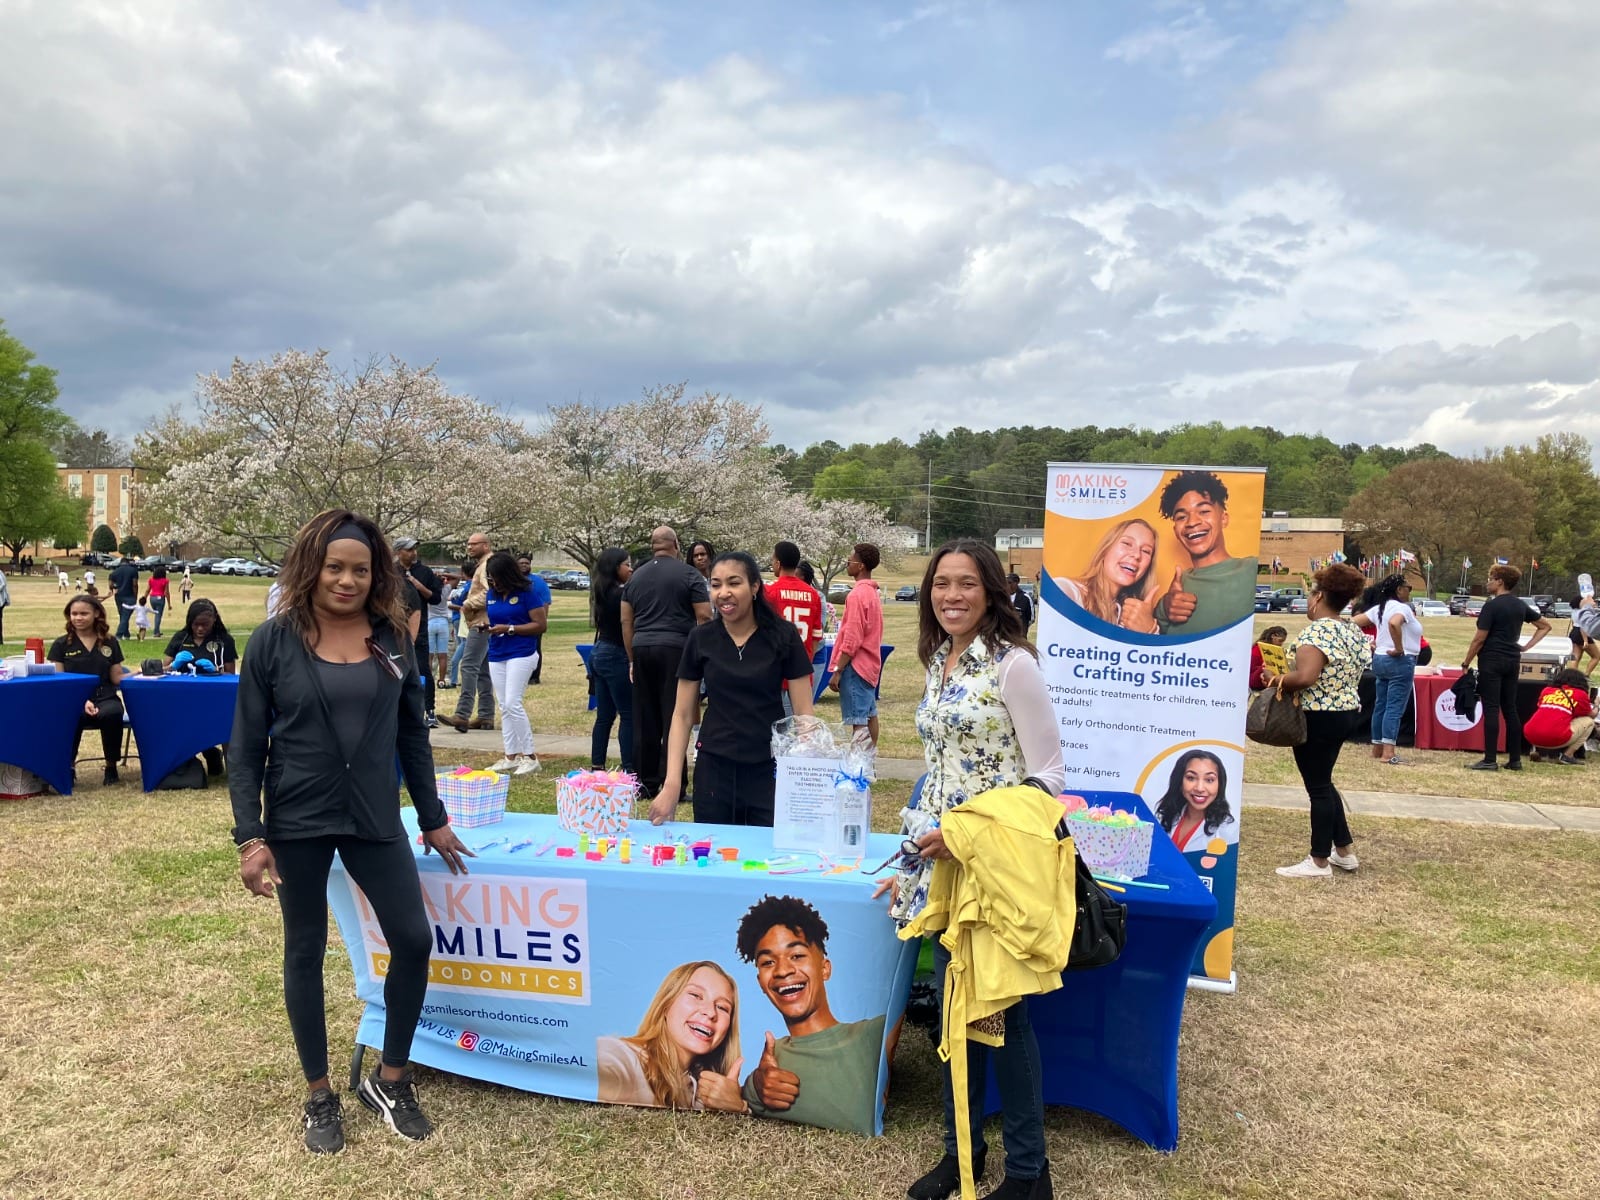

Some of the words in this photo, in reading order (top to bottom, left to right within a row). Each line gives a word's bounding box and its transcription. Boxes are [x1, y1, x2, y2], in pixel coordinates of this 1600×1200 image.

[1056, 474, 1127, 488] MAKING
[1070, 487, 1127, 499] SMILES
[780, 589, 812, 602] MAHOMES
[783, 606, 811, 643] 15
[1048, 644, 1120, 665] Creating
[1127, 649, 1233, 673] Confidence,
[1073, 664, 1145, 687] Crafting
[1151, 670, 1209, 689] Smiles
[1050, 696, 1060, 705] nd
[1062, 697, 1093, 708] adults!
[1101, 688, 1150, 701] treatments
[1153, 692, 1166, 702] for
[1168, 695, 1208, 707] children,
[1211, 699, 1237, 709] teens
[1061, 716, 1083, 728] Early
[1085, 719, 1147, 734] Orthondontic
[1149, 725, 1196, 738] Treatment
[1060, 739, 1089, 750] Braces
[1064, 764, 1081, 773] lear
[1083, 767, 1121, 779] Aligners
[357, 883, 579, 928] AKING
[435, 925, 581, 964] MILES
[377, 959, 577, 991] OHODONTICS
[420, 1003, 569, 1029] gsmilesorthodontics.com
[437, 1026, 457, 1041] US:
[478, 1038, 588, 1068] @MakingSmilesAL
